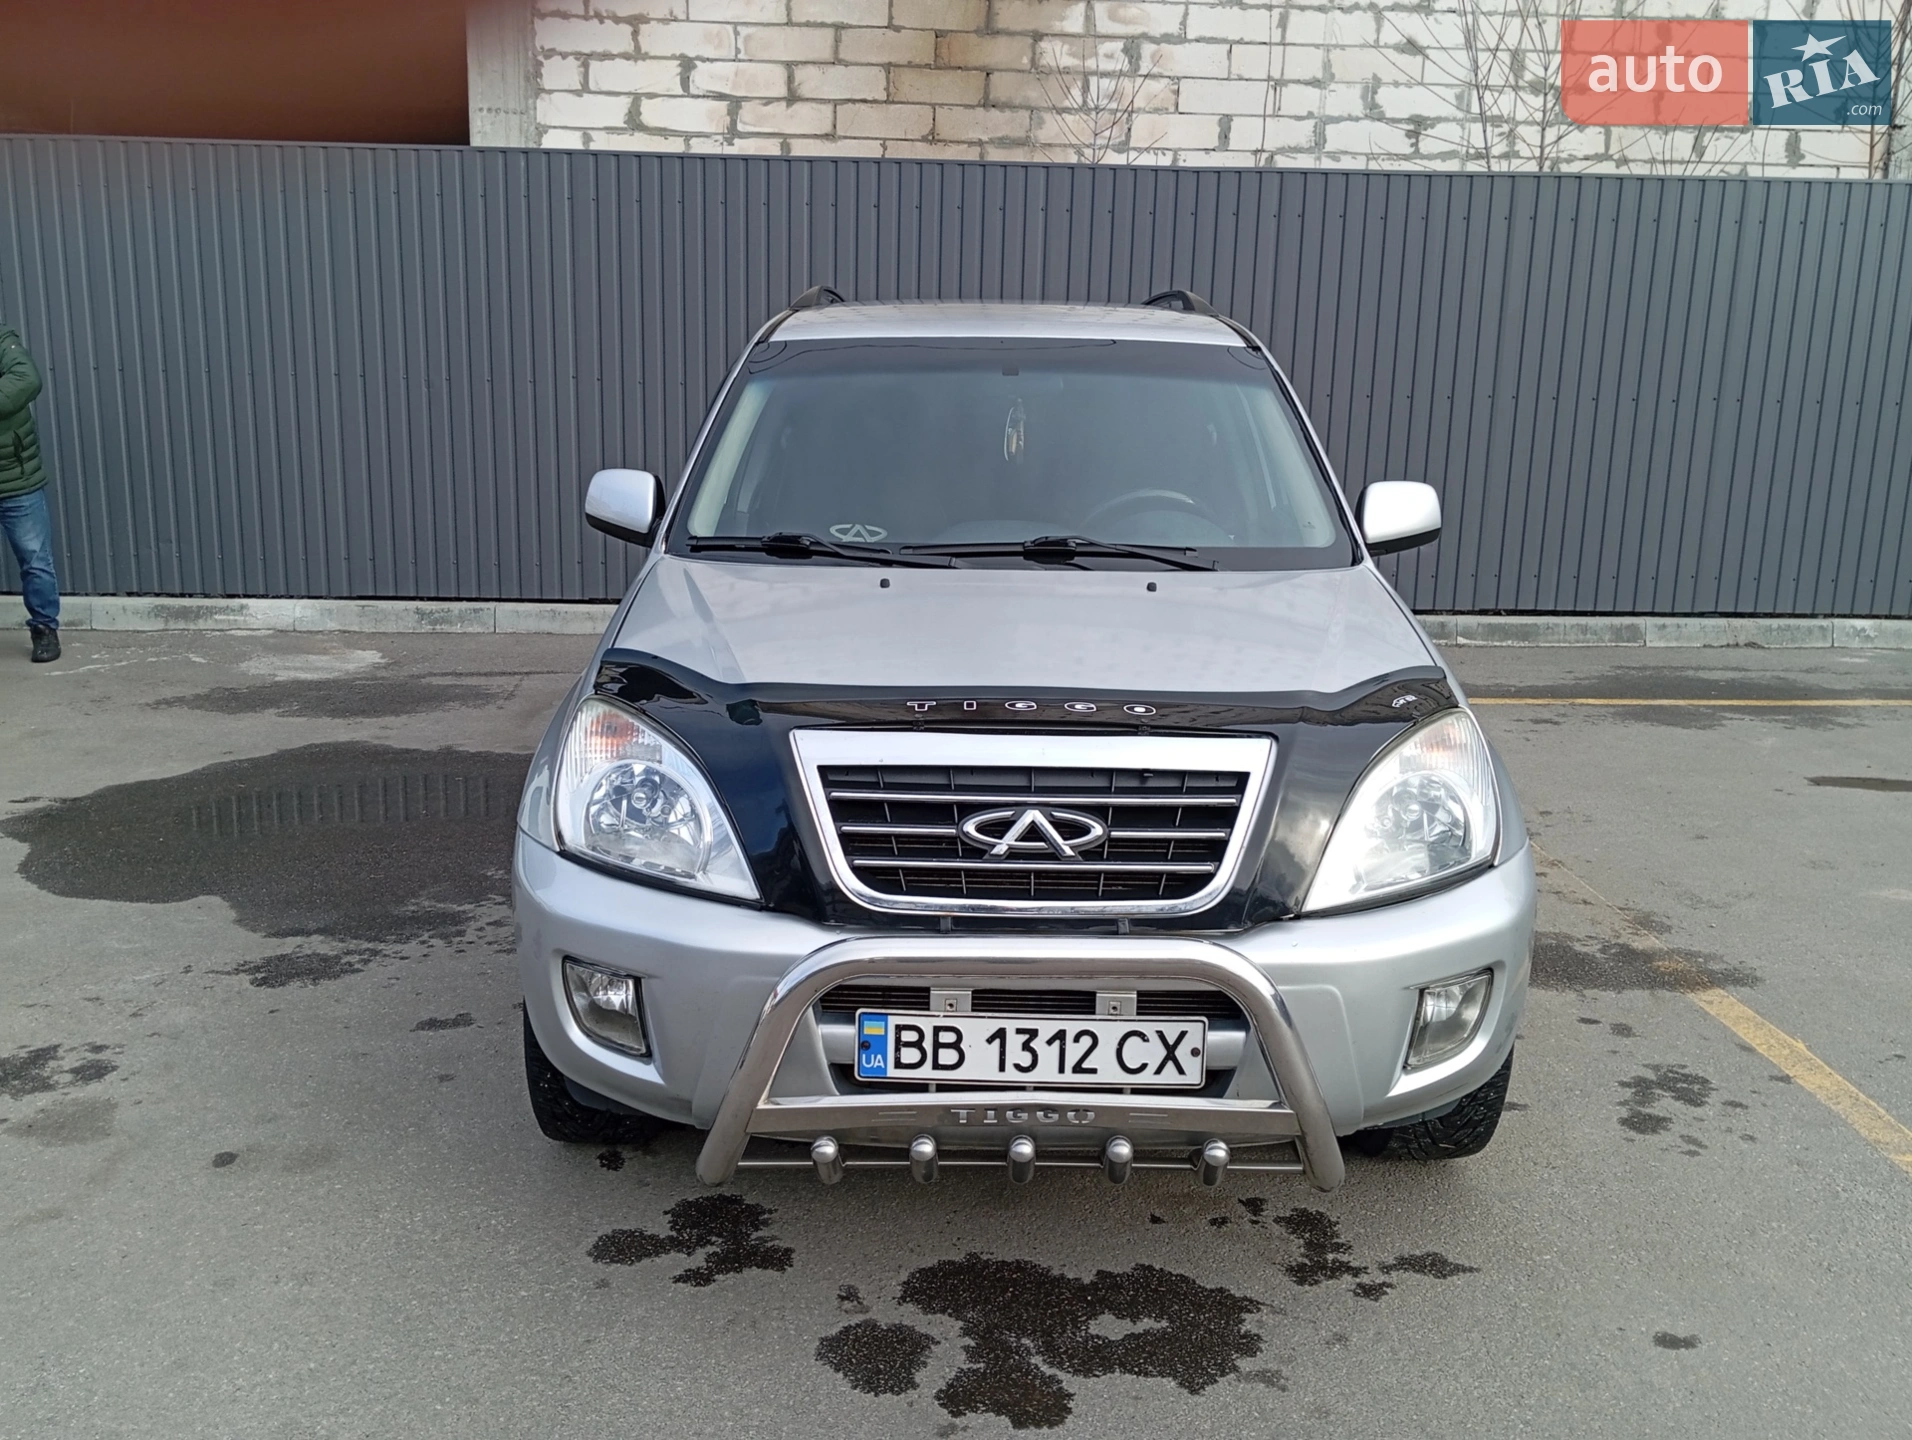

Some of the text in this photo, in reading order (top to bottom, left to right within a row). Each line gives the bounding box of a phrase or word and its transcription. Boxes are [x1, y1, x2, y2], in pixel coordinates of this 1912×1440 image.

[906, 701, 1156, 715] TIGGO
[893, 1024, 1188, 1076] BB 1312 CX
[862, 1053, 885, 1069] UA
[950, 1108, 1096, 1124] TIGGO
